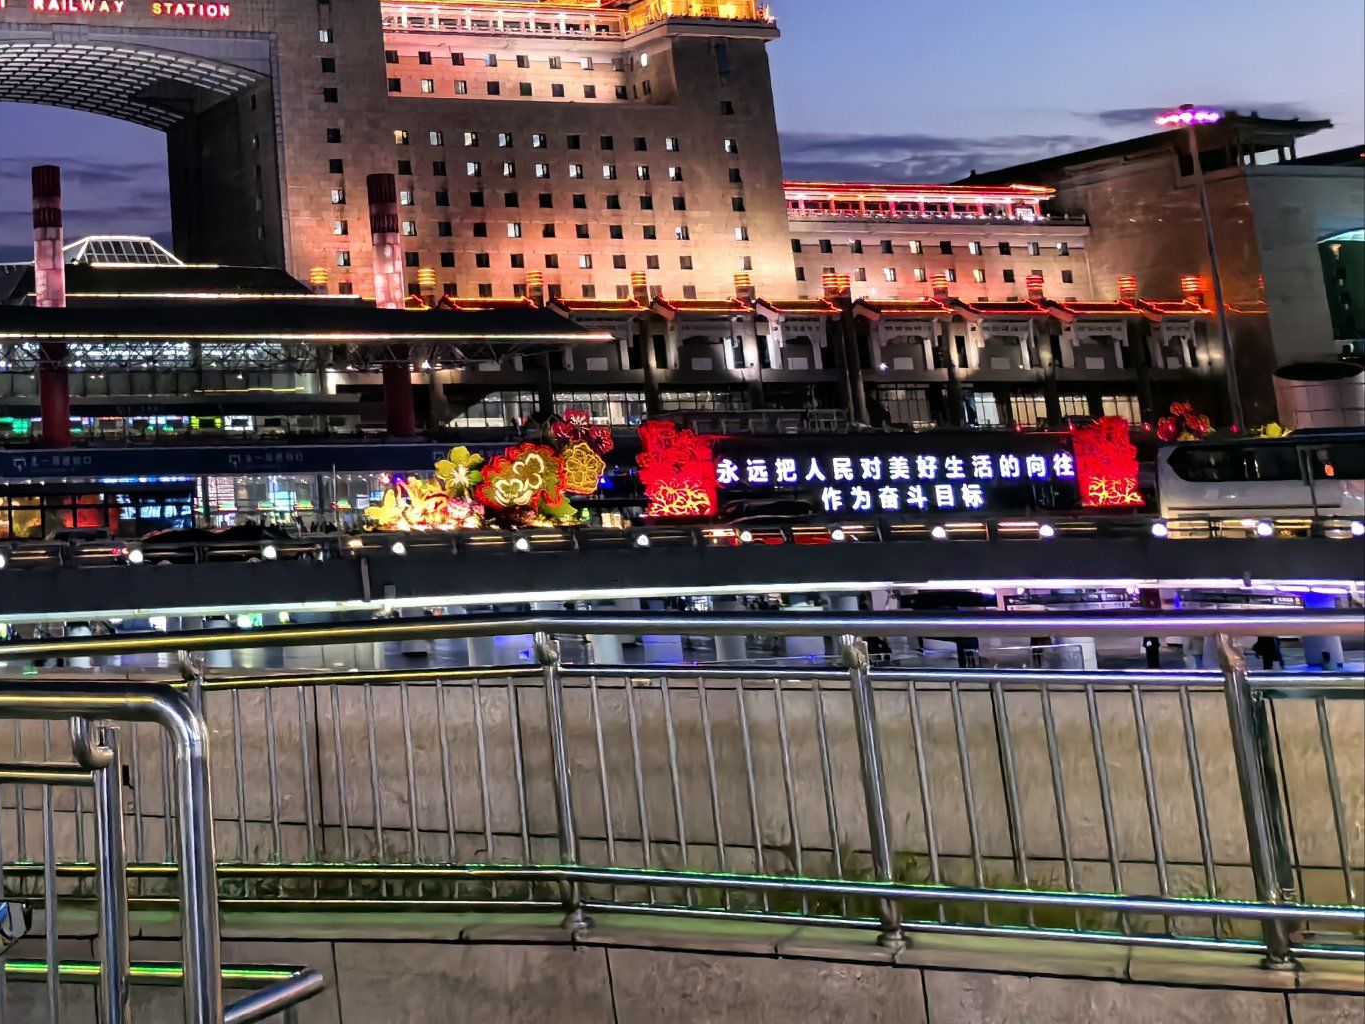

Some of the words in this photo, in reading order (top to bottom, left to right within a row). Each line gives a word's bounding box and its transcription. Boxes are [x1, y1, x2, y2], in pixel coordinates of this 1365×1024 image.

[151, 2, 231, 19] STATION
[715, 454, 1075, 483] 永远把人民对美好生活的向往
[820, 483, 985, 512] 作为奋斗目标
